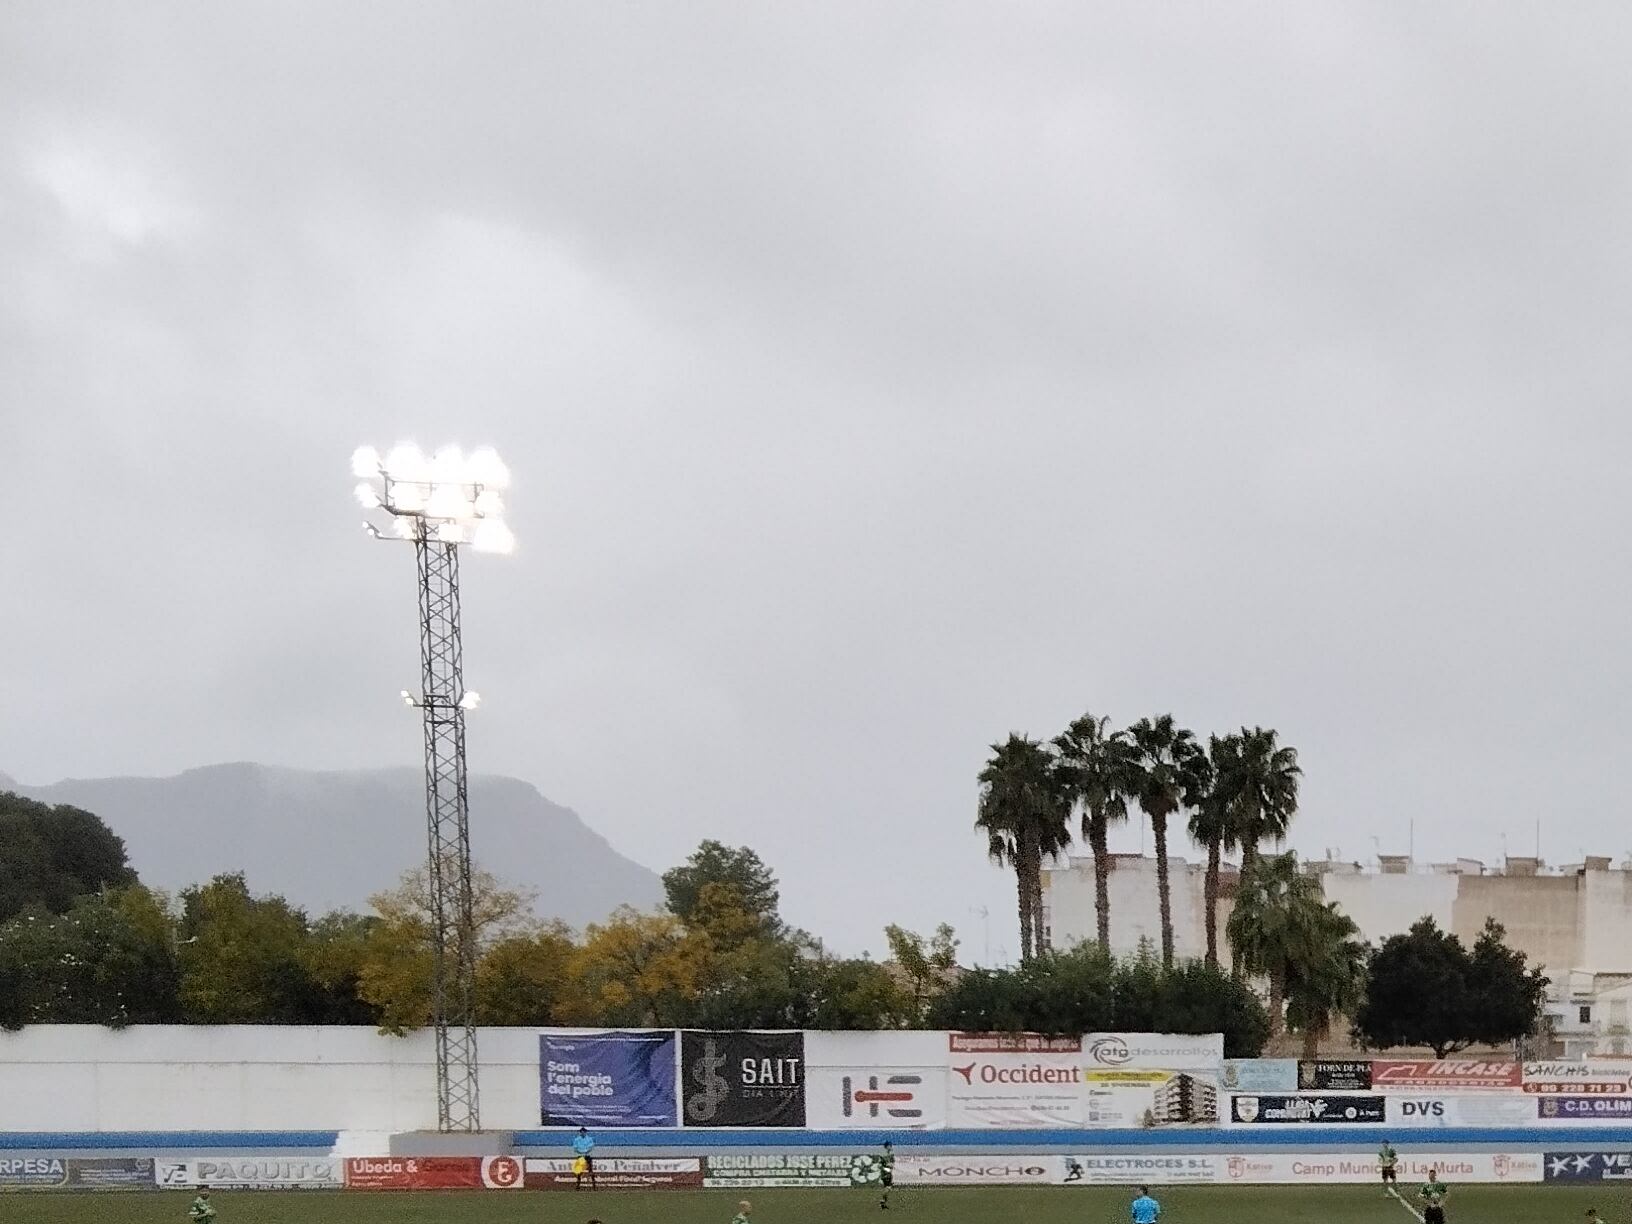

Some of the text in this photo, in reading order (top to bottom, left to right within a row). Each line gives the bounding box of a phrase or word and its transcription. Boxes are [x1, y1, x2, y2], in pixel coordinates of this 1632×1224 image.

[547, 1060, 580, 1072] Som
[742, 1058, 799, 1084] SAIT
[980, 1064, 1080, 1083] Occident
[1427, 1062, 1516, 1076] INCASE
[1524, 1064, 1590, 1077] SANCHIS
[548, 1083, 613, 1098] del poble
[1402, 1101, 1444, 1116] DVS
[1565, 1101, 1592, 1112] C.D.
[352, 1156, 402, 1173] Úbeda
[406, 1160, 418, 1173] &
[708, 1155, 785, 1169] RECICLADOS
[1292, 1162, 1335, 1176] Camp
[1412, 1161, 1428, 1174] La
[1434, 1161, 1474, 1174] Murta
[197, 1162, 332, 1180] PAQUITO
